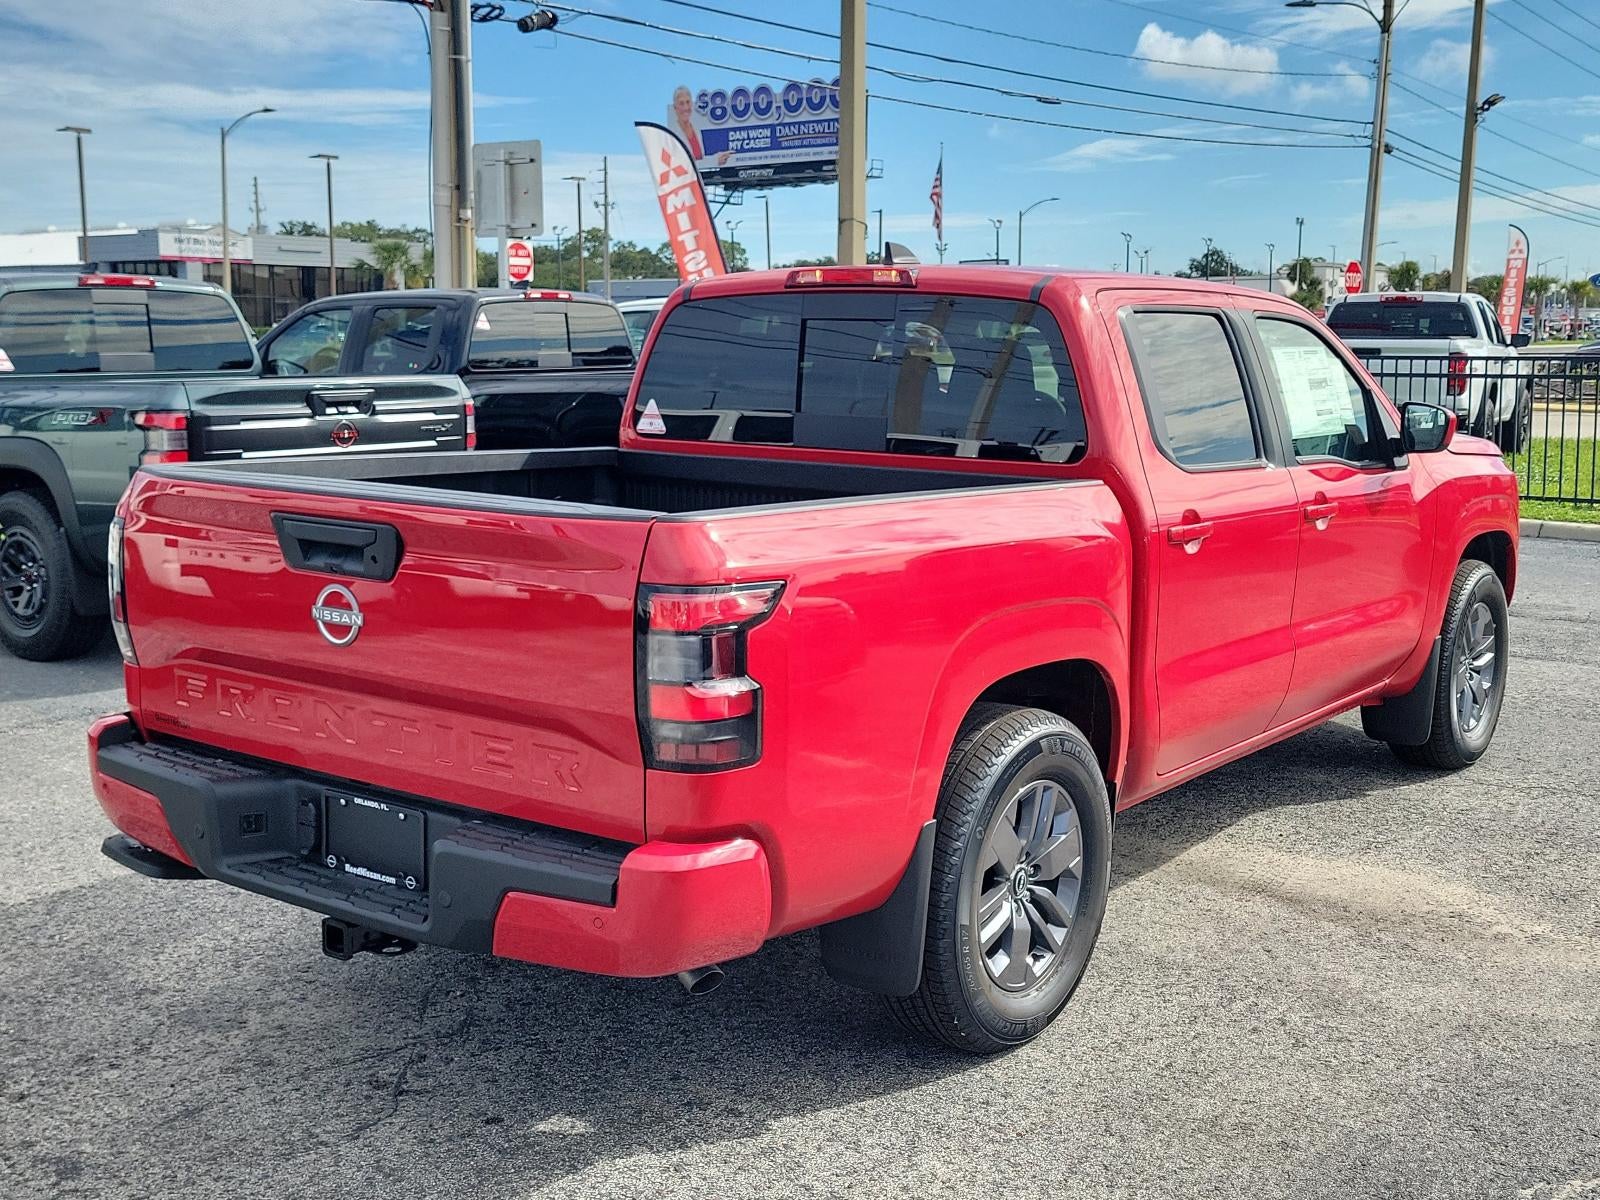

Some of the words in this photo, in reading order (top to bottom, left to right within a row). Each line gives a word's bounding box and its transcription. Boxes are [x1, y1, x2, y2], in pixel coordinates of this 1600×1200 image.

[728, 131, 748, 141] DAN
[748, 127, 771, 139] WON
[776, 124, 799, 137] DAN
[728, 141, 743, 150] MY
[508, 248, 517, 256] DO
[509, 265, 528, 274] ENTER
[1345, 272, 1362, 288] STOP
[313, 607, 362, 626] NISSAN
[173, 667, 583, 793] FRONTIER
[344, 863, 397, 885] ReedNissan.com
